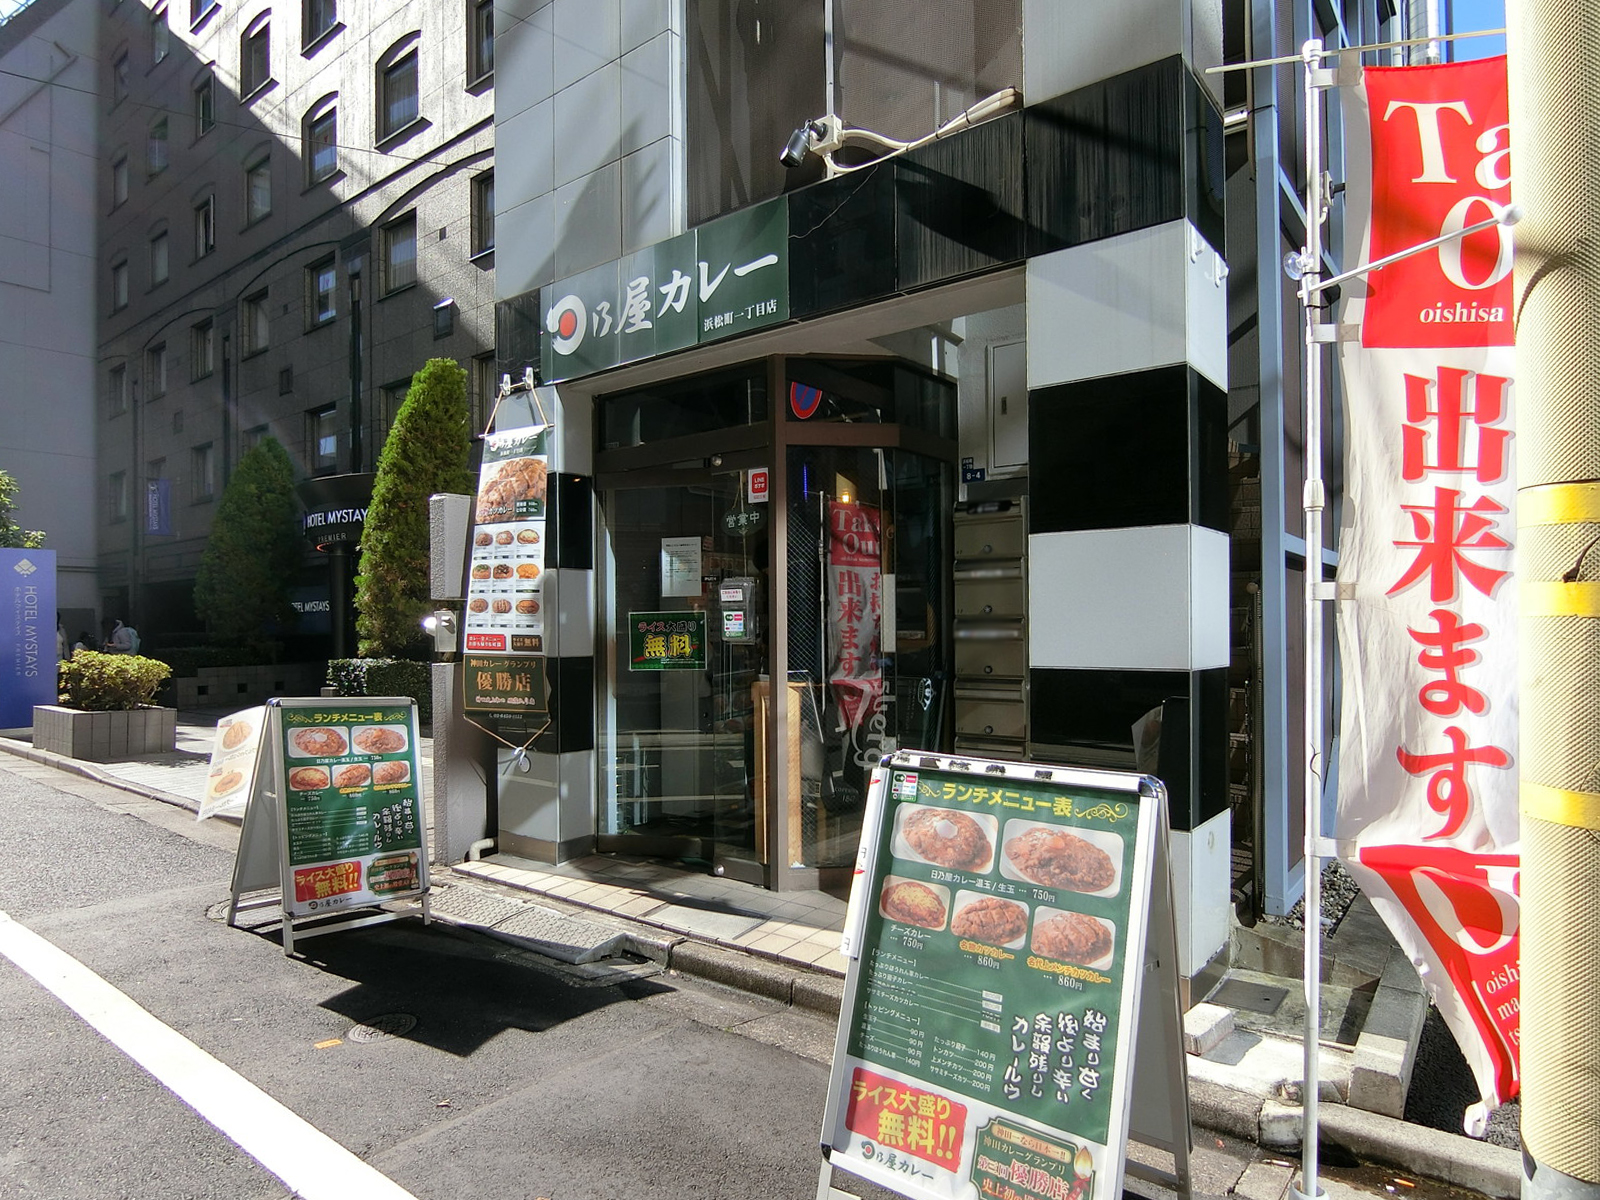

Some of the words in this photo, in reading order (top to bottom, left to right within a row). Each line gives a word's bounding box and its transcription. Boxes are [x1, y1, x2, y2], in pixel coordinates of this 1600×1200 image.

[1382, 100, 1512, 190] Ta
[1438, 195, 1514, 290] O
[704, 299, 778, 332] 浜松町一丁目店
[1419, 302, 1504, 323] oishisa
[966, 471, 981, 480] 8-4
[307, 512, 326, 528] HOTEL
[327, 508, 368, 525] MYSTAY
[726, 511, 760, 528] 営業中
[24, 586, 38, 621] HOTEL
[304, 601, 330, 612] MYSTAYS
[1385, 365, 1514, 842] 出来ます
[638, 620, 697, 633] ライス大盛り
[837, 570, 862, 677] 出来ます
[24, 625, 38, 677] MYSTAYS
[644, 633, 692, 659] 無料
[470, 659, 536, 669] 神田カレーグランプリ
[477, 671, 531, 691] 優勝店
[314, 712, 383, 723] ランチメニュー表
[943, 783, 1072, 817] ランチメニュー表
[296, 862, 354, 887] ライス大盛り
[315, 872, 359, 898] 無料!!
[1032, 888, 1056, 903] 750円
[890, 924, 932, 939] チーズカレー
[902, 936, 924, 950] 750円
[959, 939, 1014, 960] 名物カツカレー
[869, 960, 930, 980] たっぷりほうれん草カレー
[977, 955, 1000, 970] 860円
[1027, 956, 1111, 984] 名代上メンチカツカレー
[1058, 974, 1083, 991] 860円
[867, 987, 920, 1008] ササミチーズカツカレー
[860, 1032, 875, 1042] チーズ
[905, 1056, 921, 1068] 140円
[933, 1046, 955, 1059] トンカツ
[974, 1060, 994, 1072] 200円
[976, 1049, 996, 1062] 140円
[1004, 1016, 1029, 1099] カレールウ
[1029, 1013, 1052, 1097] 余韻残りし
[1053, 1013, 1078, 1103] 後より辛い
[1079, 1009, 1107, 1099] 始まり甘く
[930, 1066, 967, 1084] ササミチーズカツ
[971, 1080, 991, 1092] 200円
[931, 1056, 963, 1071] 上メンチカツ
[972, 1070, 992, 1082] 200円
[853, 1080, 951, 1120] ライス大盛り
[878, 1108, 956, 1160] 無料!!
[983, 1135, 1066, 1175] 神田カレーグランプリ
